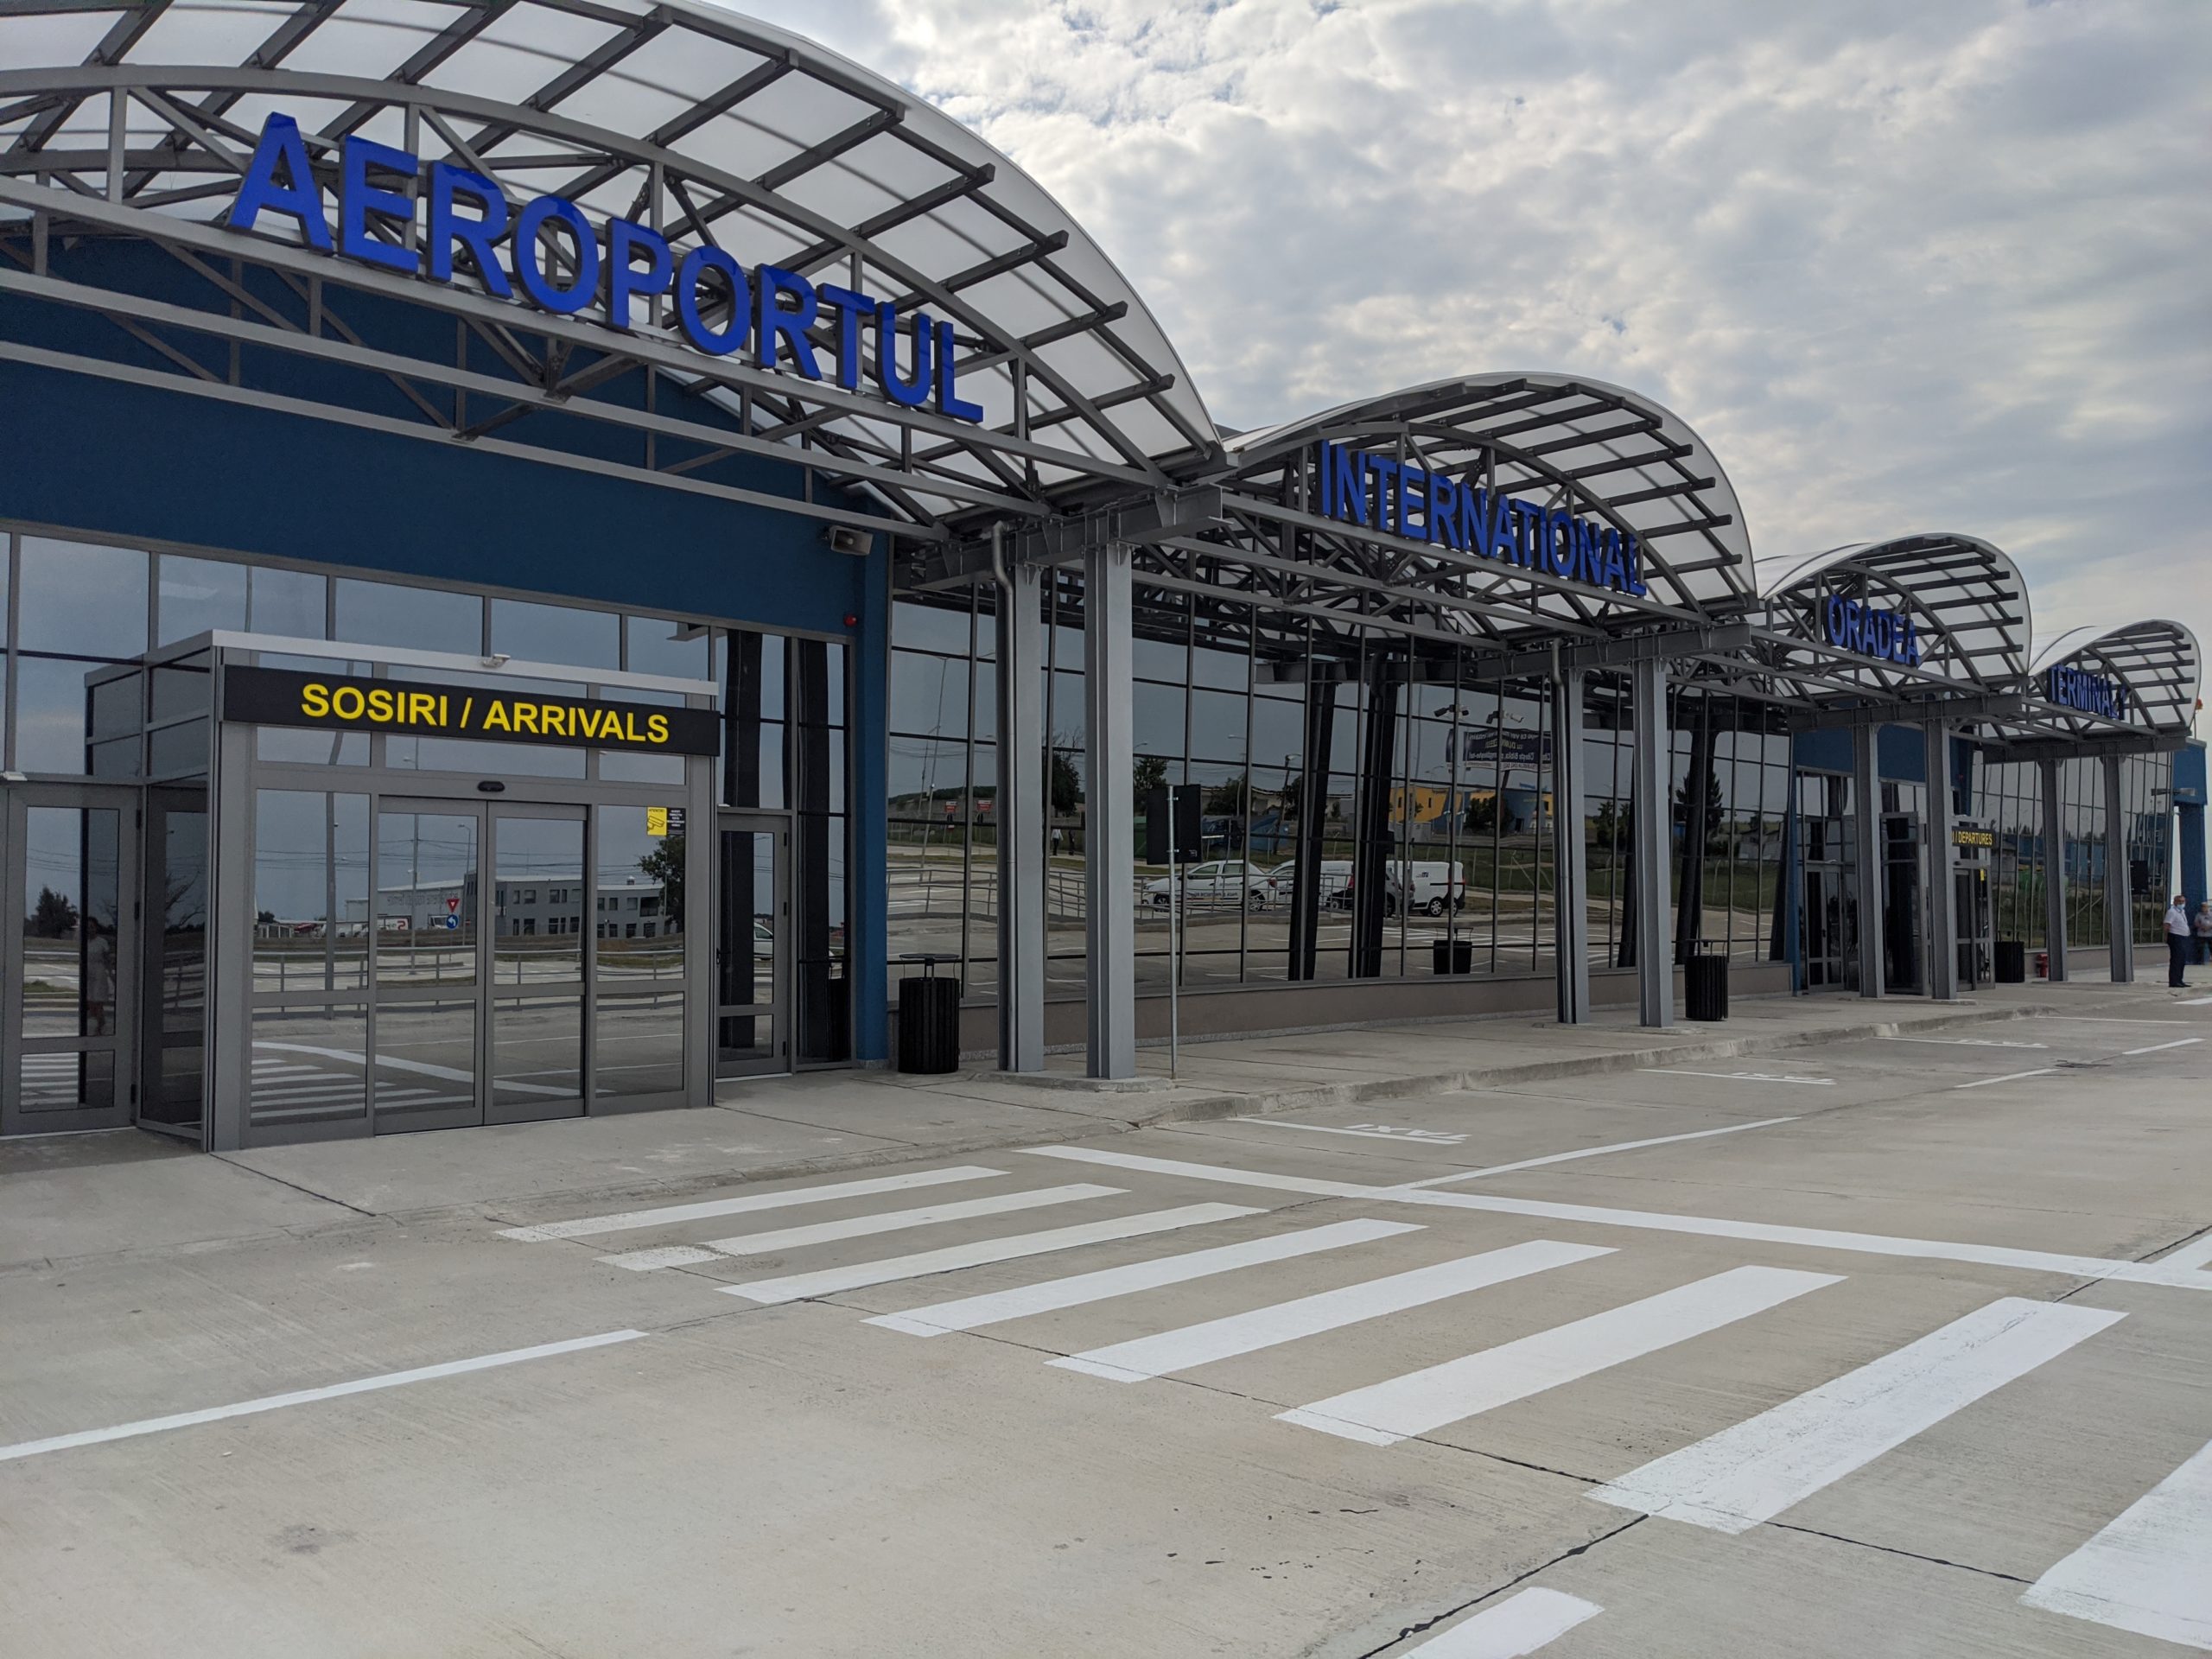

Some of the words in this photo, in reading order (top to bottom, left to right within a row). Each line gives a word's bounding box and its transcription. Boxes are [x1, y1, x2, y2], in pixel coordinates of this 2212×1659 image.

[226, 111, 983, 423] AEROPORTUL
[1317, 439, 1646, 596] INTERNATIONAL
[1827, 594, 1921, 667] ORADEA
[301, 683, 448, 728] SOSIRI
[460, 697, 473, 729] /
[482, 700, 670, 744] ARRIVALS
[2049, 664, 2120, 719] TERMINAL
[1958, 831, 1993, 845] DEPARTURES
